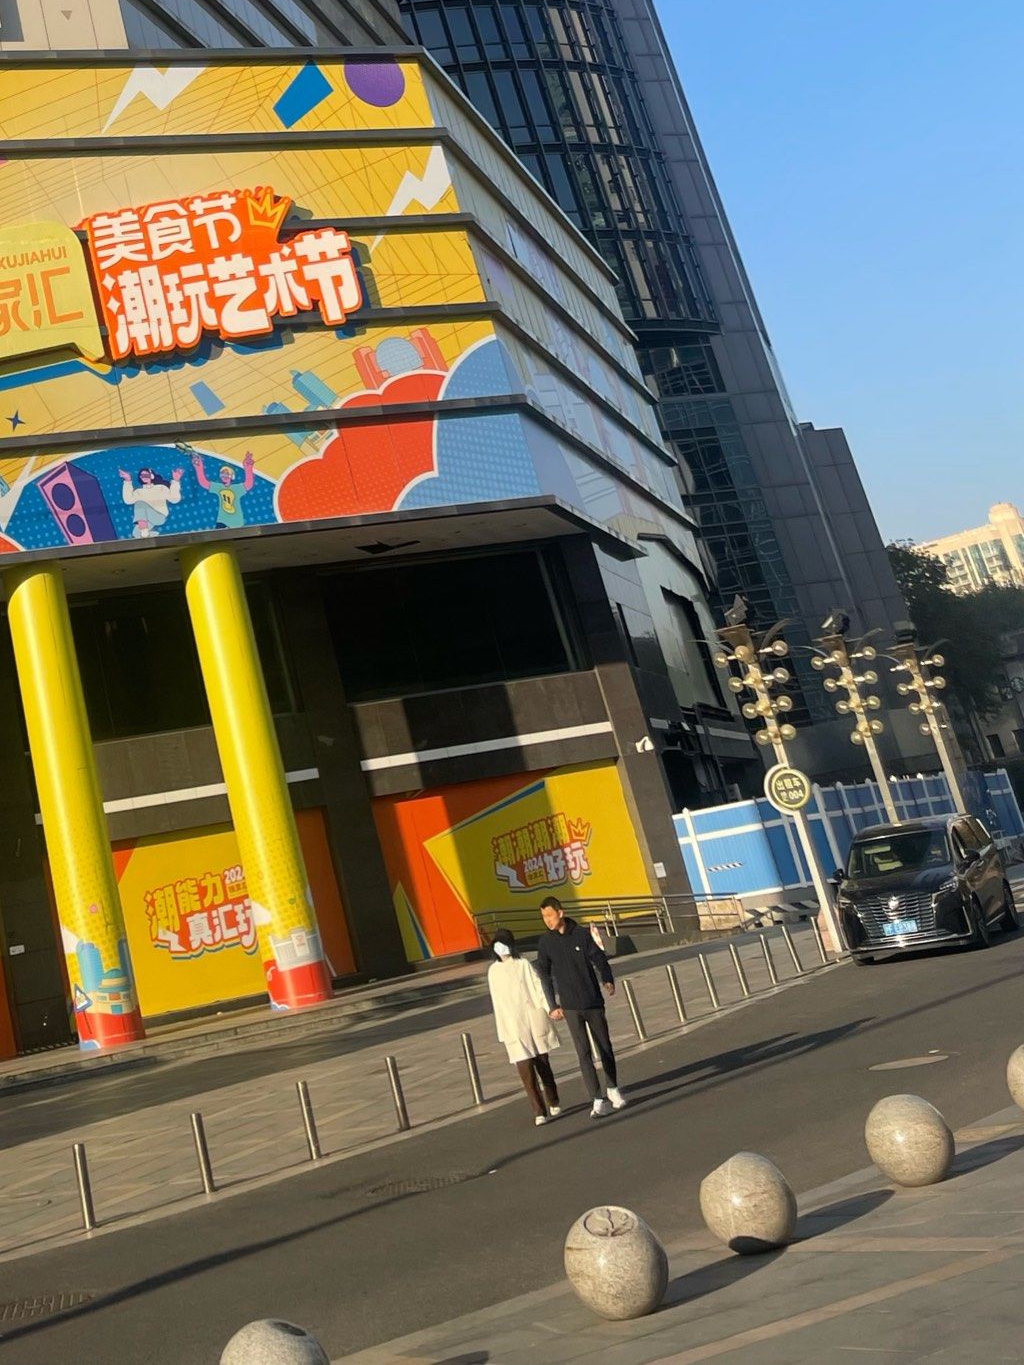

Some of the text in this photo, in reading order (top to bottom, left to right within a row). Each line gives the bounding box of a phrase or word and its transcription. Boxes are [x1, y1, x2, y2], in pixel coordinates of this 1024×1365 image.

[92, 193, 243, 270] 美食节
[106, 231, 360, 355] 潮玩艺术节
[224, 866, 244, 884] 202
[543, 841, 589, 882] 好玩
[144, 873, 224, 941] 潮能力
